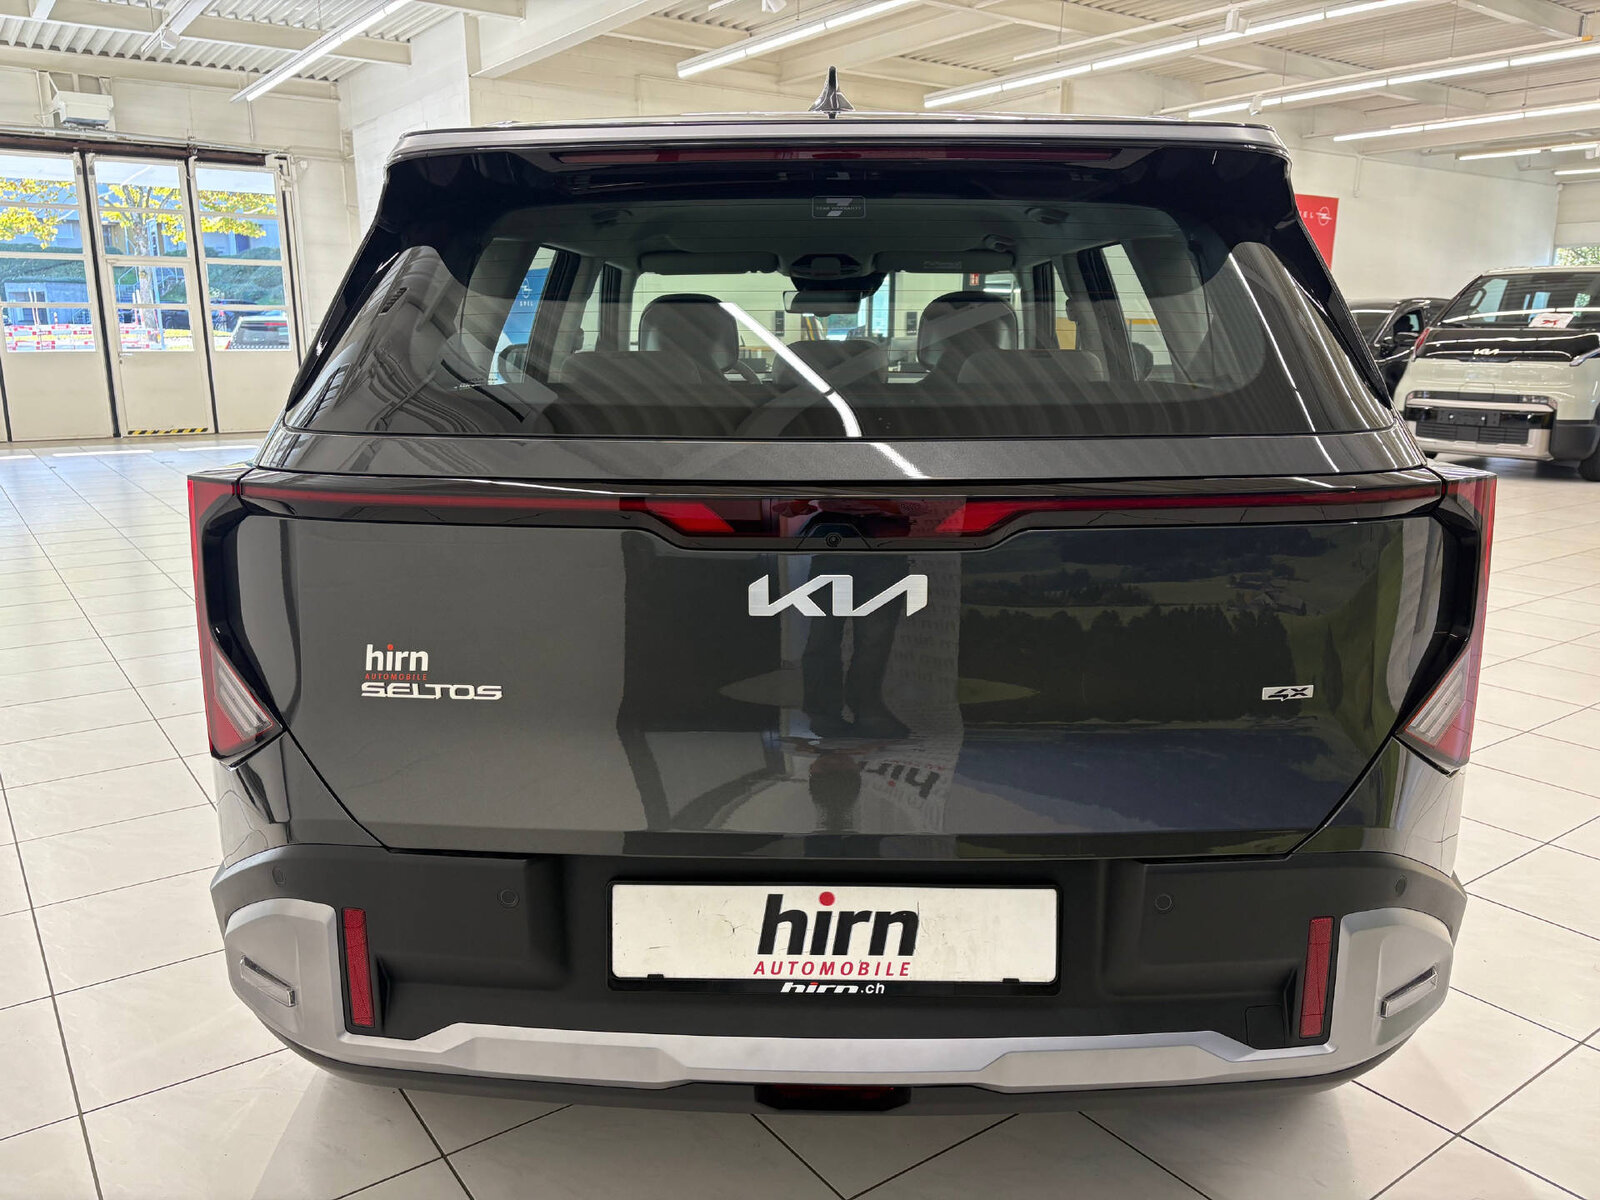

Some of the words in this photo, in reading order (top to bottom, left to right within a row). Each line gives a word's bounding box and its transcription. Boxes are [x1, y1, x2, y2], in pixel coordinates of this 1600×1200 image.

[748, 574, 928, 617] KIA
[365, 643, 429, 672] hirn
[364, 673, 428, 682] AUTOMOBILE
[361, 682, 503, 701] SELTOS
[757, 891, 919, 957] hirn
[753, 961, 911, 976] AUTOMOBILE
[780, 982, 885, 994] hirn.ch
